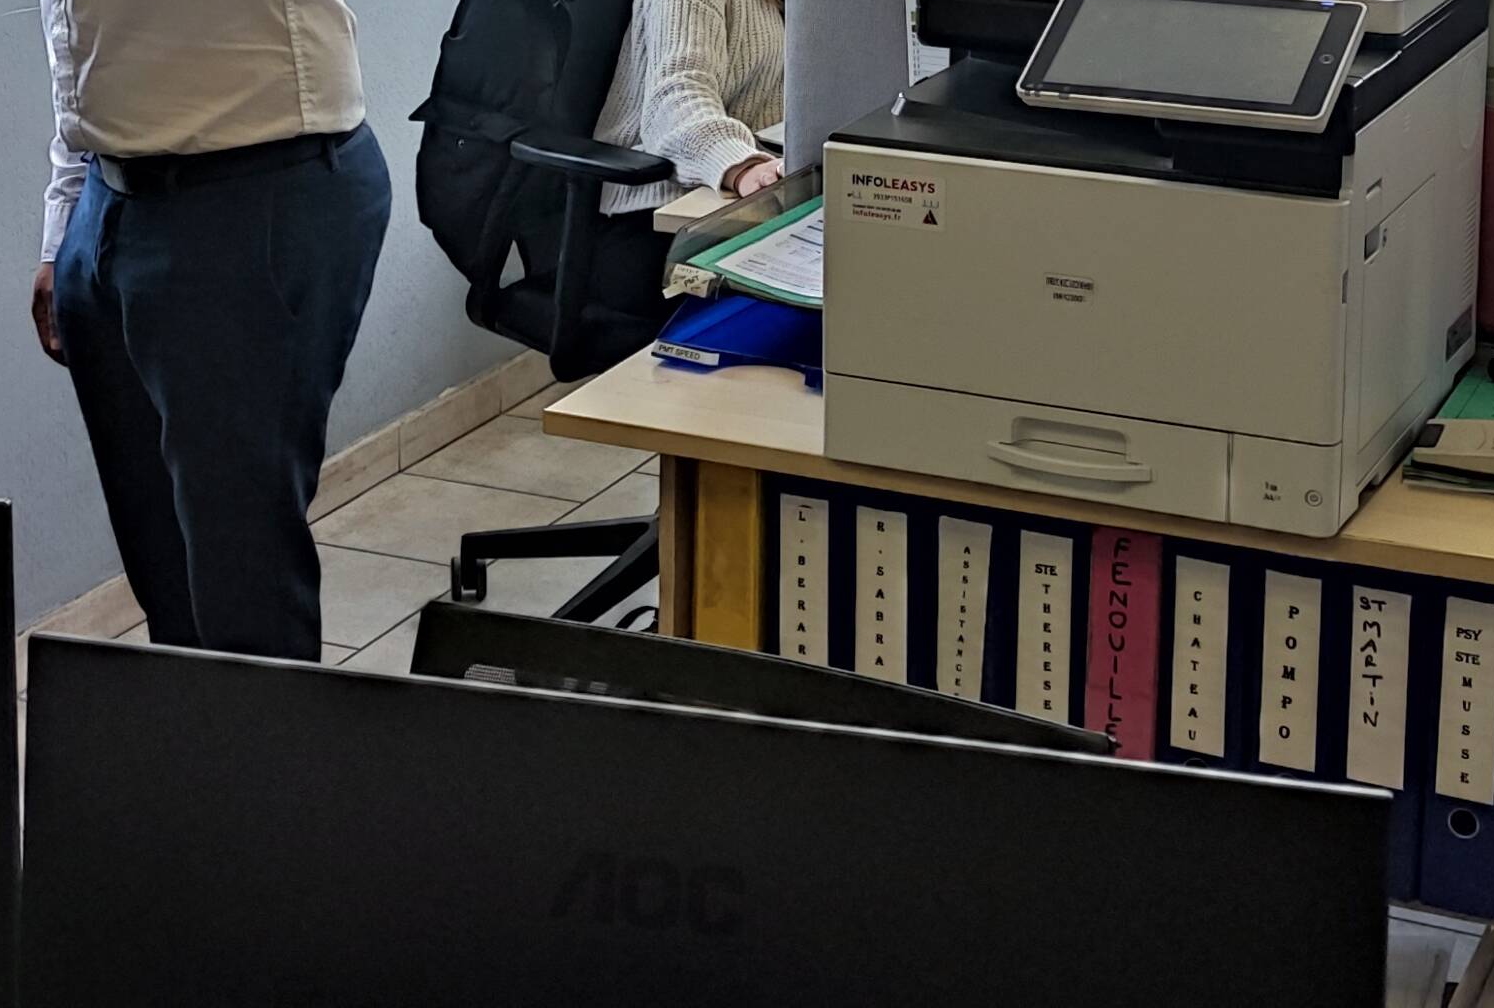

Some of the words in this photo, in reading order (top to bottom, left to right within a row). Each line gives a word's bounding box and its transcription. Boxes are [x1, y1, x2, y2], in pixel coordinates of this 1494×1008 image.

[851, 174, 936, 194] INFOLEASYS
[852, 208, 901, 221] infoleasys.fr
[675, 347, 701, 361] SPEED
[1035, 563, 1058, 576] STE
[1359, 596, 1387, 613] ST
[955, 546, 970, 696] ASSISTANCE
[1456, 627, 1482, 641] PSY
[1042, 584, 1052, 710] THERESE
[1188, 591, 1202, 741] CHATEAU
[1454, 652, 1480, 665] STE
[1278, 605, 1300, 740] POMPO
[1459, 677, 1473, 785] MUSSE
